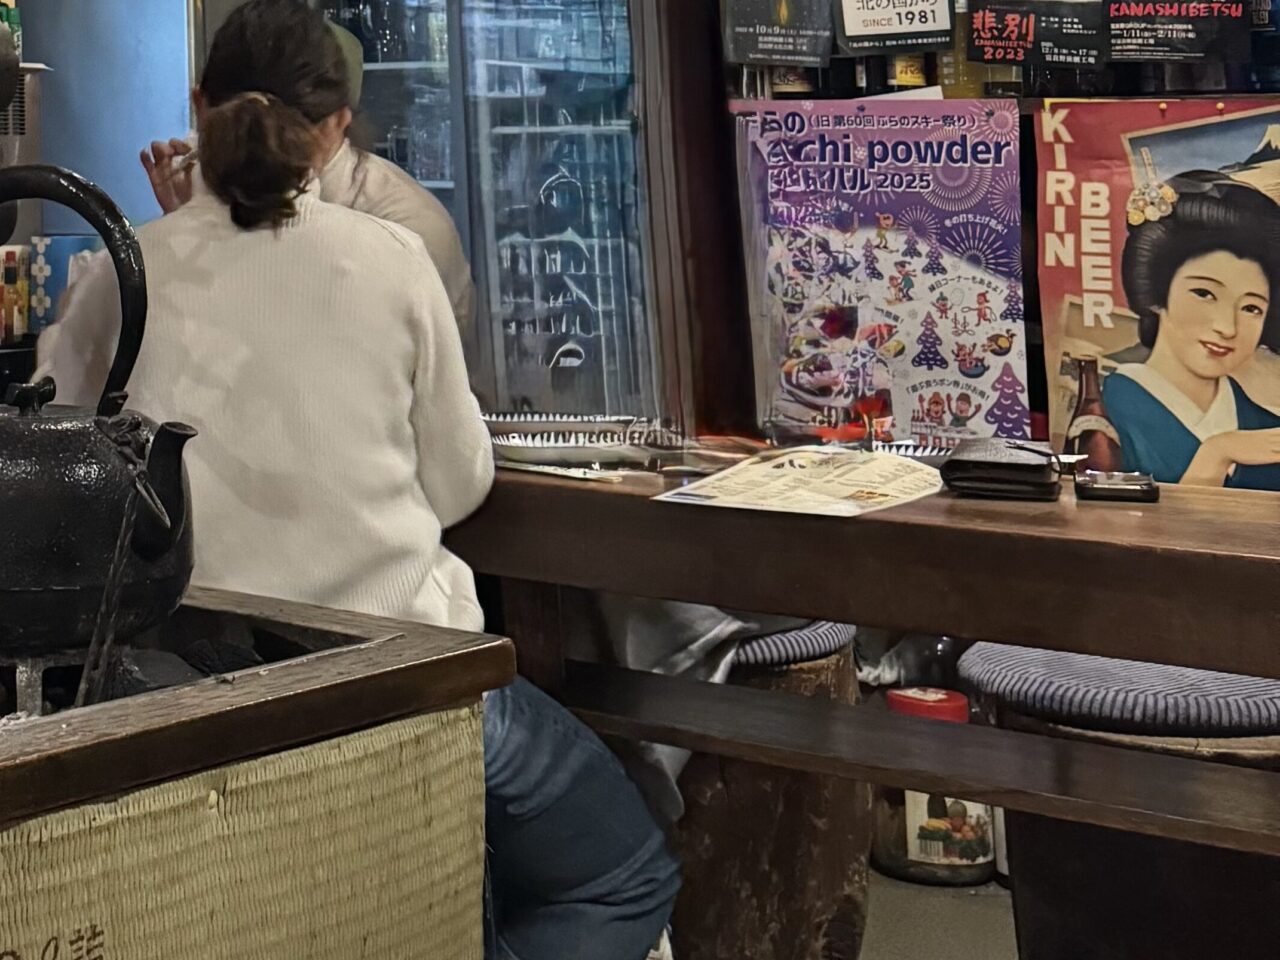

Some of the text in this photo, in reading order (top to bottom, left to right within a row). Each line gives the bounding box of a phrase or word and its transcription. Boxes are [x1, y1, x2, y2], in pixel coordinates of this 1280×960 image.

[862, 9, 937, 28] SINCE 1981
[1109, 2, 1243, 18] KANASHIBETSU
[972, 9, 1036, 43] 悲別
[983, 48, 1025, 61] 2023
[834, 114, 875, 128] 第60回
[868, 133, 1012, 170] powder
[876, 173, 932, 191] 2025
[1041, 108, 1076, 268] KIRIN
[1080, 181, 1115, 329] BEER
